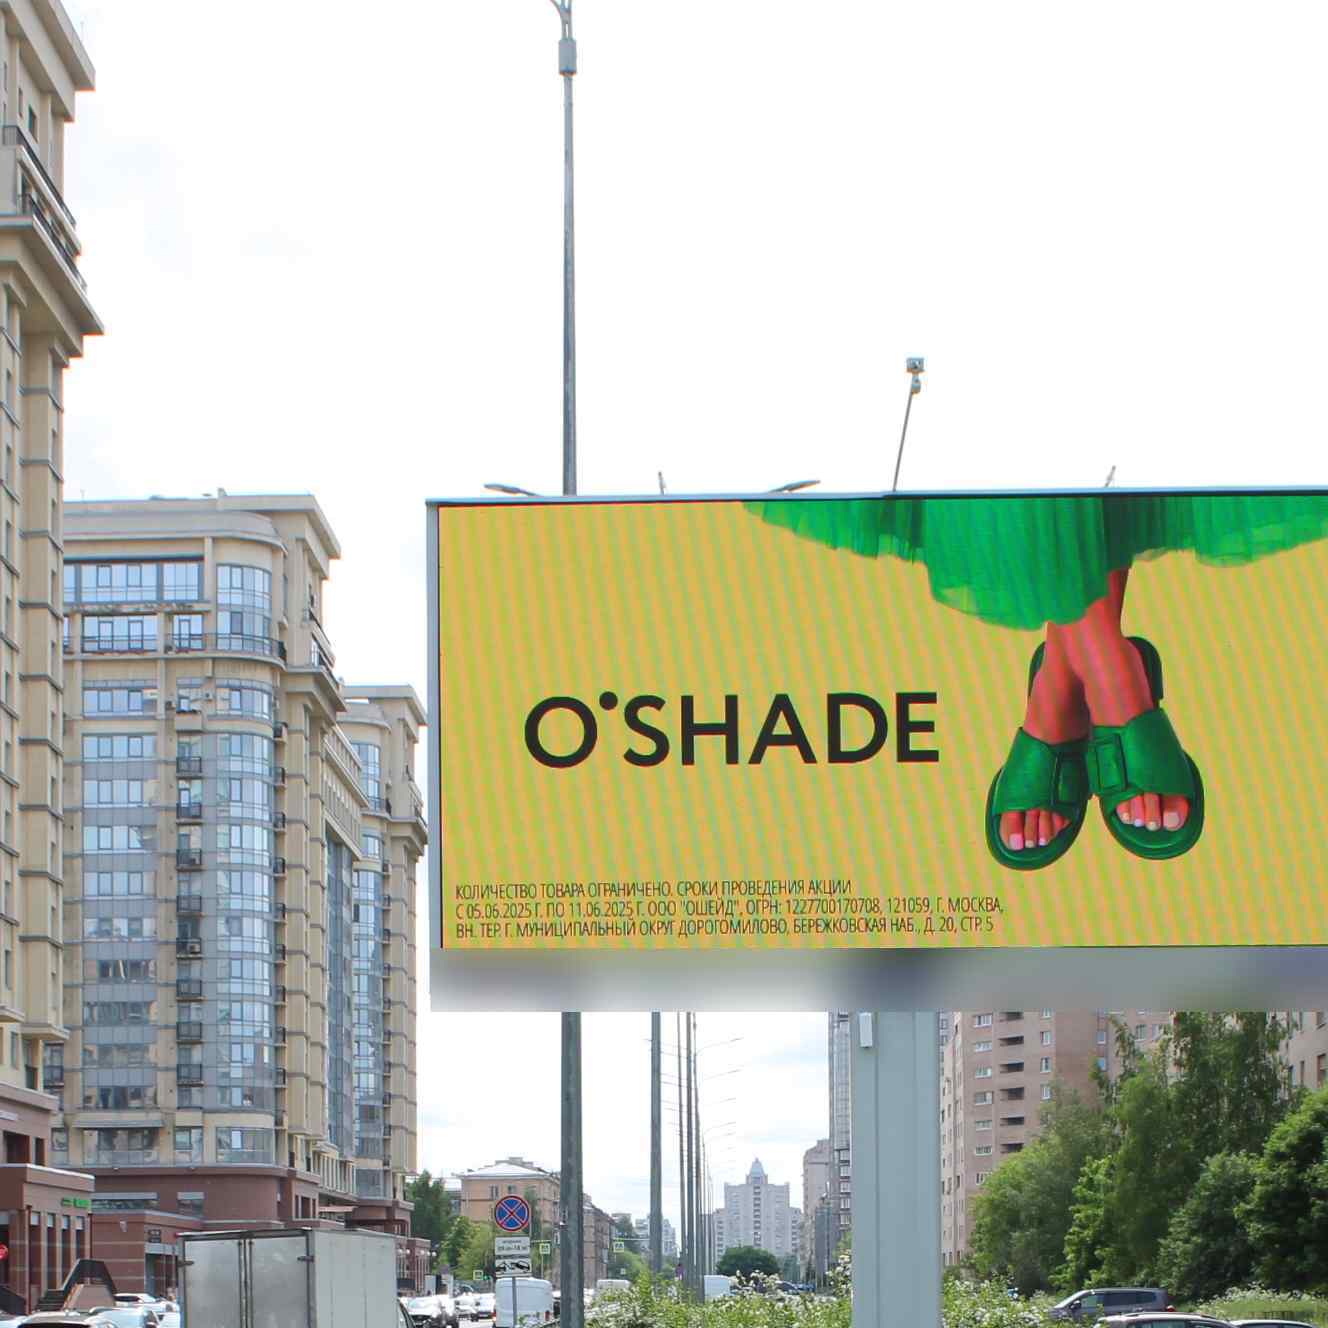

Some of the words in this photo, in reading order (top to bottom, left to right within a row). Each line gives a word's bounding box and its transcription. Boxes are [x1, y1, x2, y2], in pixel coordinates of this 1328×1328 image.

[455, 883, 537, 900] КОЛИЧЕСТВО
[540, 883, 585, 898] ТОВАРА
[588, 881, 673, 897] ОГРАНИЧЕНО.
[676, 881, 718, 897] СРОКИ
[721, 880, 804, 897] ПРОВЕДЕНИЯ
[808, 879, 851, 897] АКЦИИ
[455, 903, 465, 919] С
[466, 903, 532, 919] 05.06.2025
[534, 902, 544, 918] Г.
[546, 902, 565, 918] ПО
[570, 901, 633, 918] 11.06.2025
[635, 901, 645, 917] Г.
[647, 901, 677, 916] ООО
[746, 899, 782, 915] ОГРН:
[888, 897, 934, 914] 121059,
[936, 897, 945, 913] Г.
[948, 896, 1004, 913] МОСКВА,
[516, 918, 636, 940] МУНИЦИПАЛЬНЫЙ
[639, 920, 675, 935] ОКРУГ
[678, 918, 790, 938] ДОРОГОМИЛОВО,
[793, 917, 887, 934] БЕРЕЖКОВСКАЯ
[938, 916, 958, 933] 20,
[985, 916, 994, 932] 5
